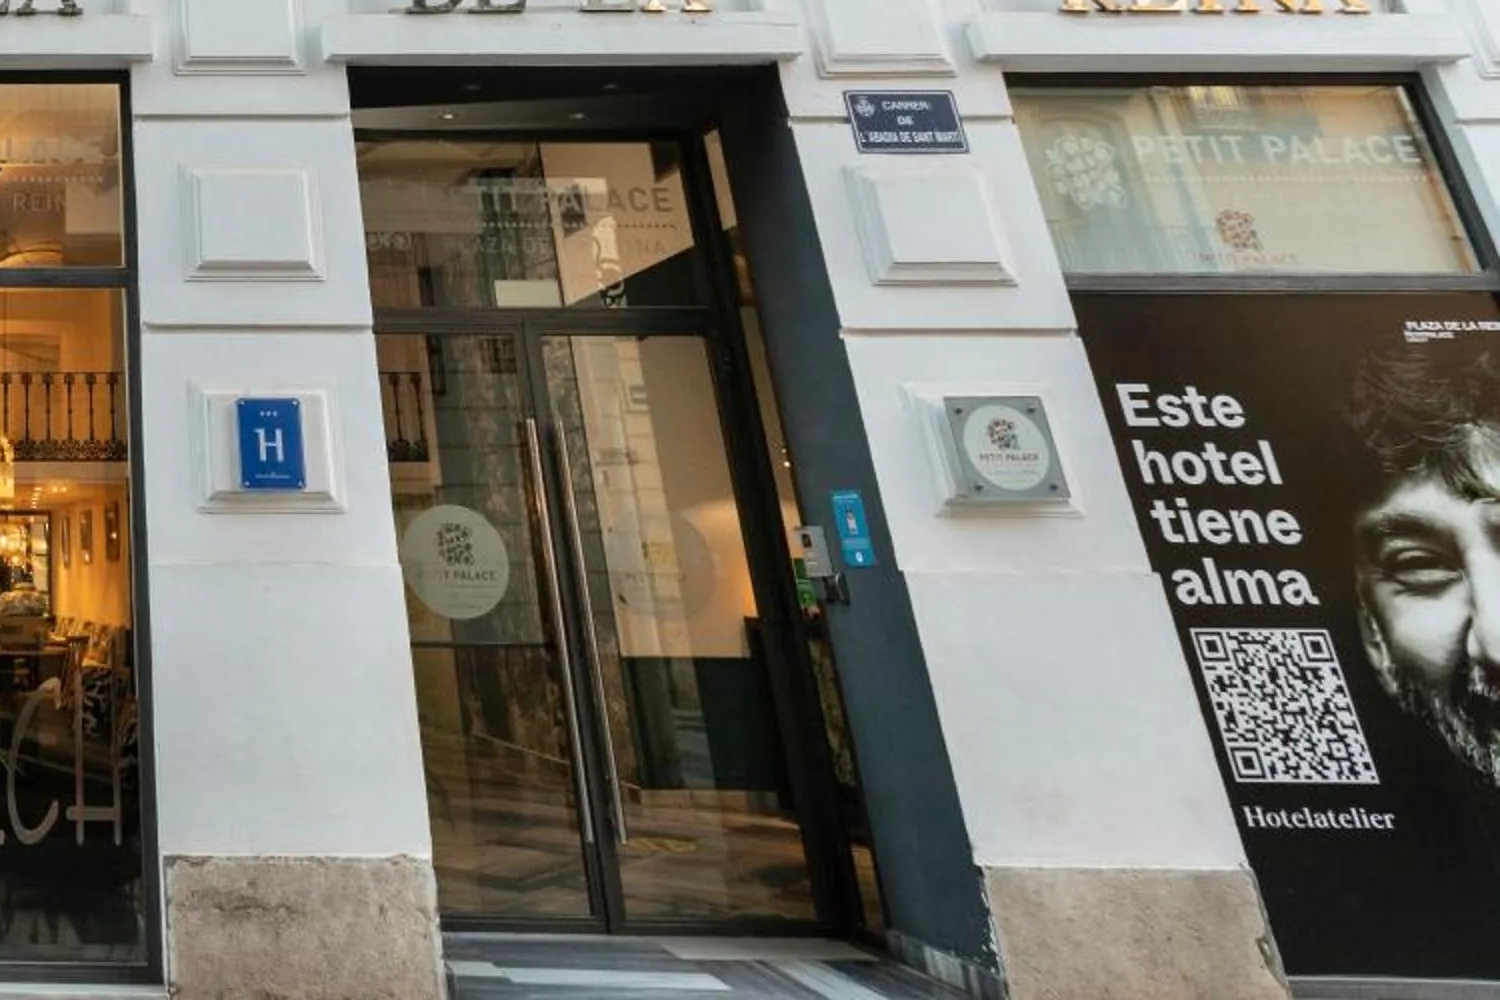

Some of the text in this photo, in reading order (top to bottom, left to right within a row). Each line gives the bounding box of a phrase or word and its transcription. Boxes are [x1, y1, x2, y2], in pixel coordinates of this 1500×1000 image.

[881, 101, 930, 111] CARRER
[897, 115, 914, 126] DE
[913, 131, 934, 143] SANT
[1132, 134, 1421, 165] PETIT PALACE
[13, 192, 68, 212] REIN
[1405, 321, 1444, 331] PLAZA
[1444, 321, 1461, 331] DE
[1115, 383, 1246, 428] Este
[253, 428, 284, 463] H
[1132, 440, 1283, 486] hotel
[1150, 498, 1304, 545] tiene
[1171, 557, 1321, 606] alma
[1241, 806, 1396, 830] Hotelatelier
